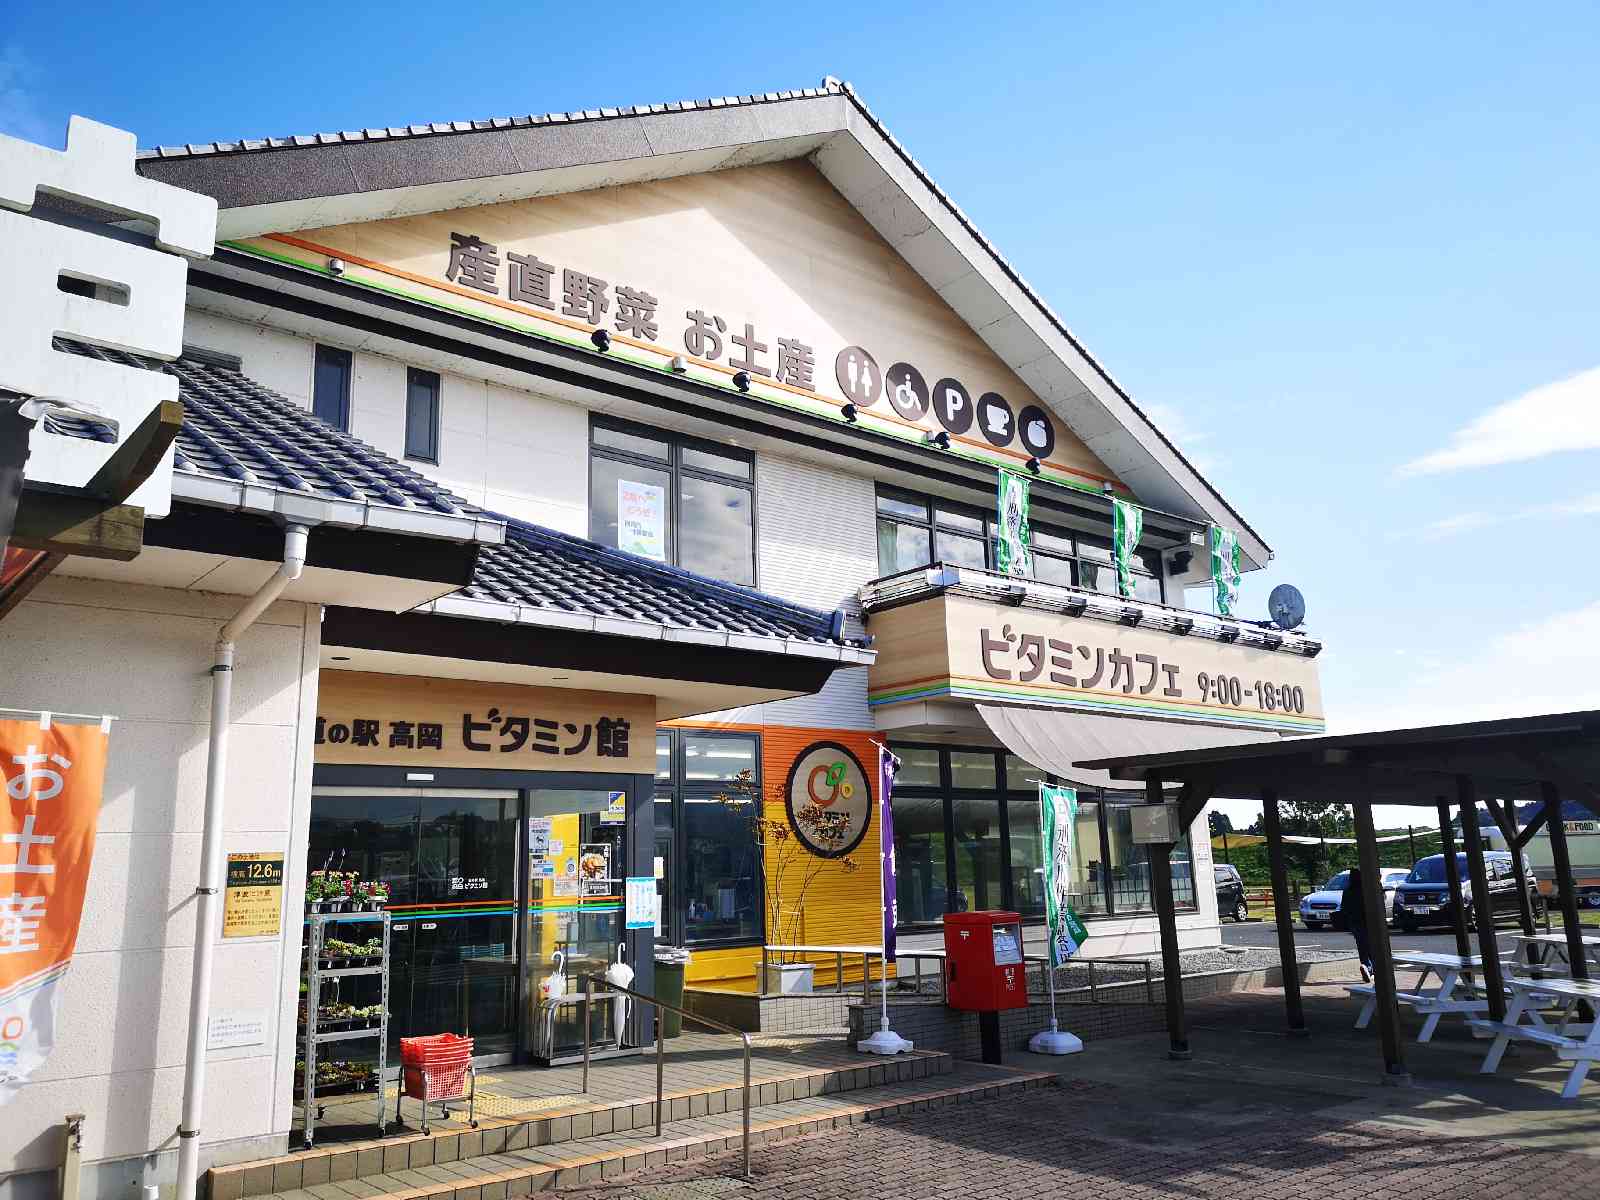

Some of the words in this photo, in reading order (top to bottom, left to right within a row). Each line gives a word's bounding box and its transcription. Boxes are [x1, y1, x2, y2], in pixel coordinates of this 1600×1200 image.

[445, 231, 659, 341] 産直野菜
[684, 310, 815, 392] お土産
[946, 388, 964, 421] P
[980, 623, 1182, 698] ビタミンカフェ
[389, 721, 443, 750] 高岡
[462, 708, 631, 758] ビタミン館
[0, 745, 72, 953] お土産
[247, 863, 281, 878] 12.6m
